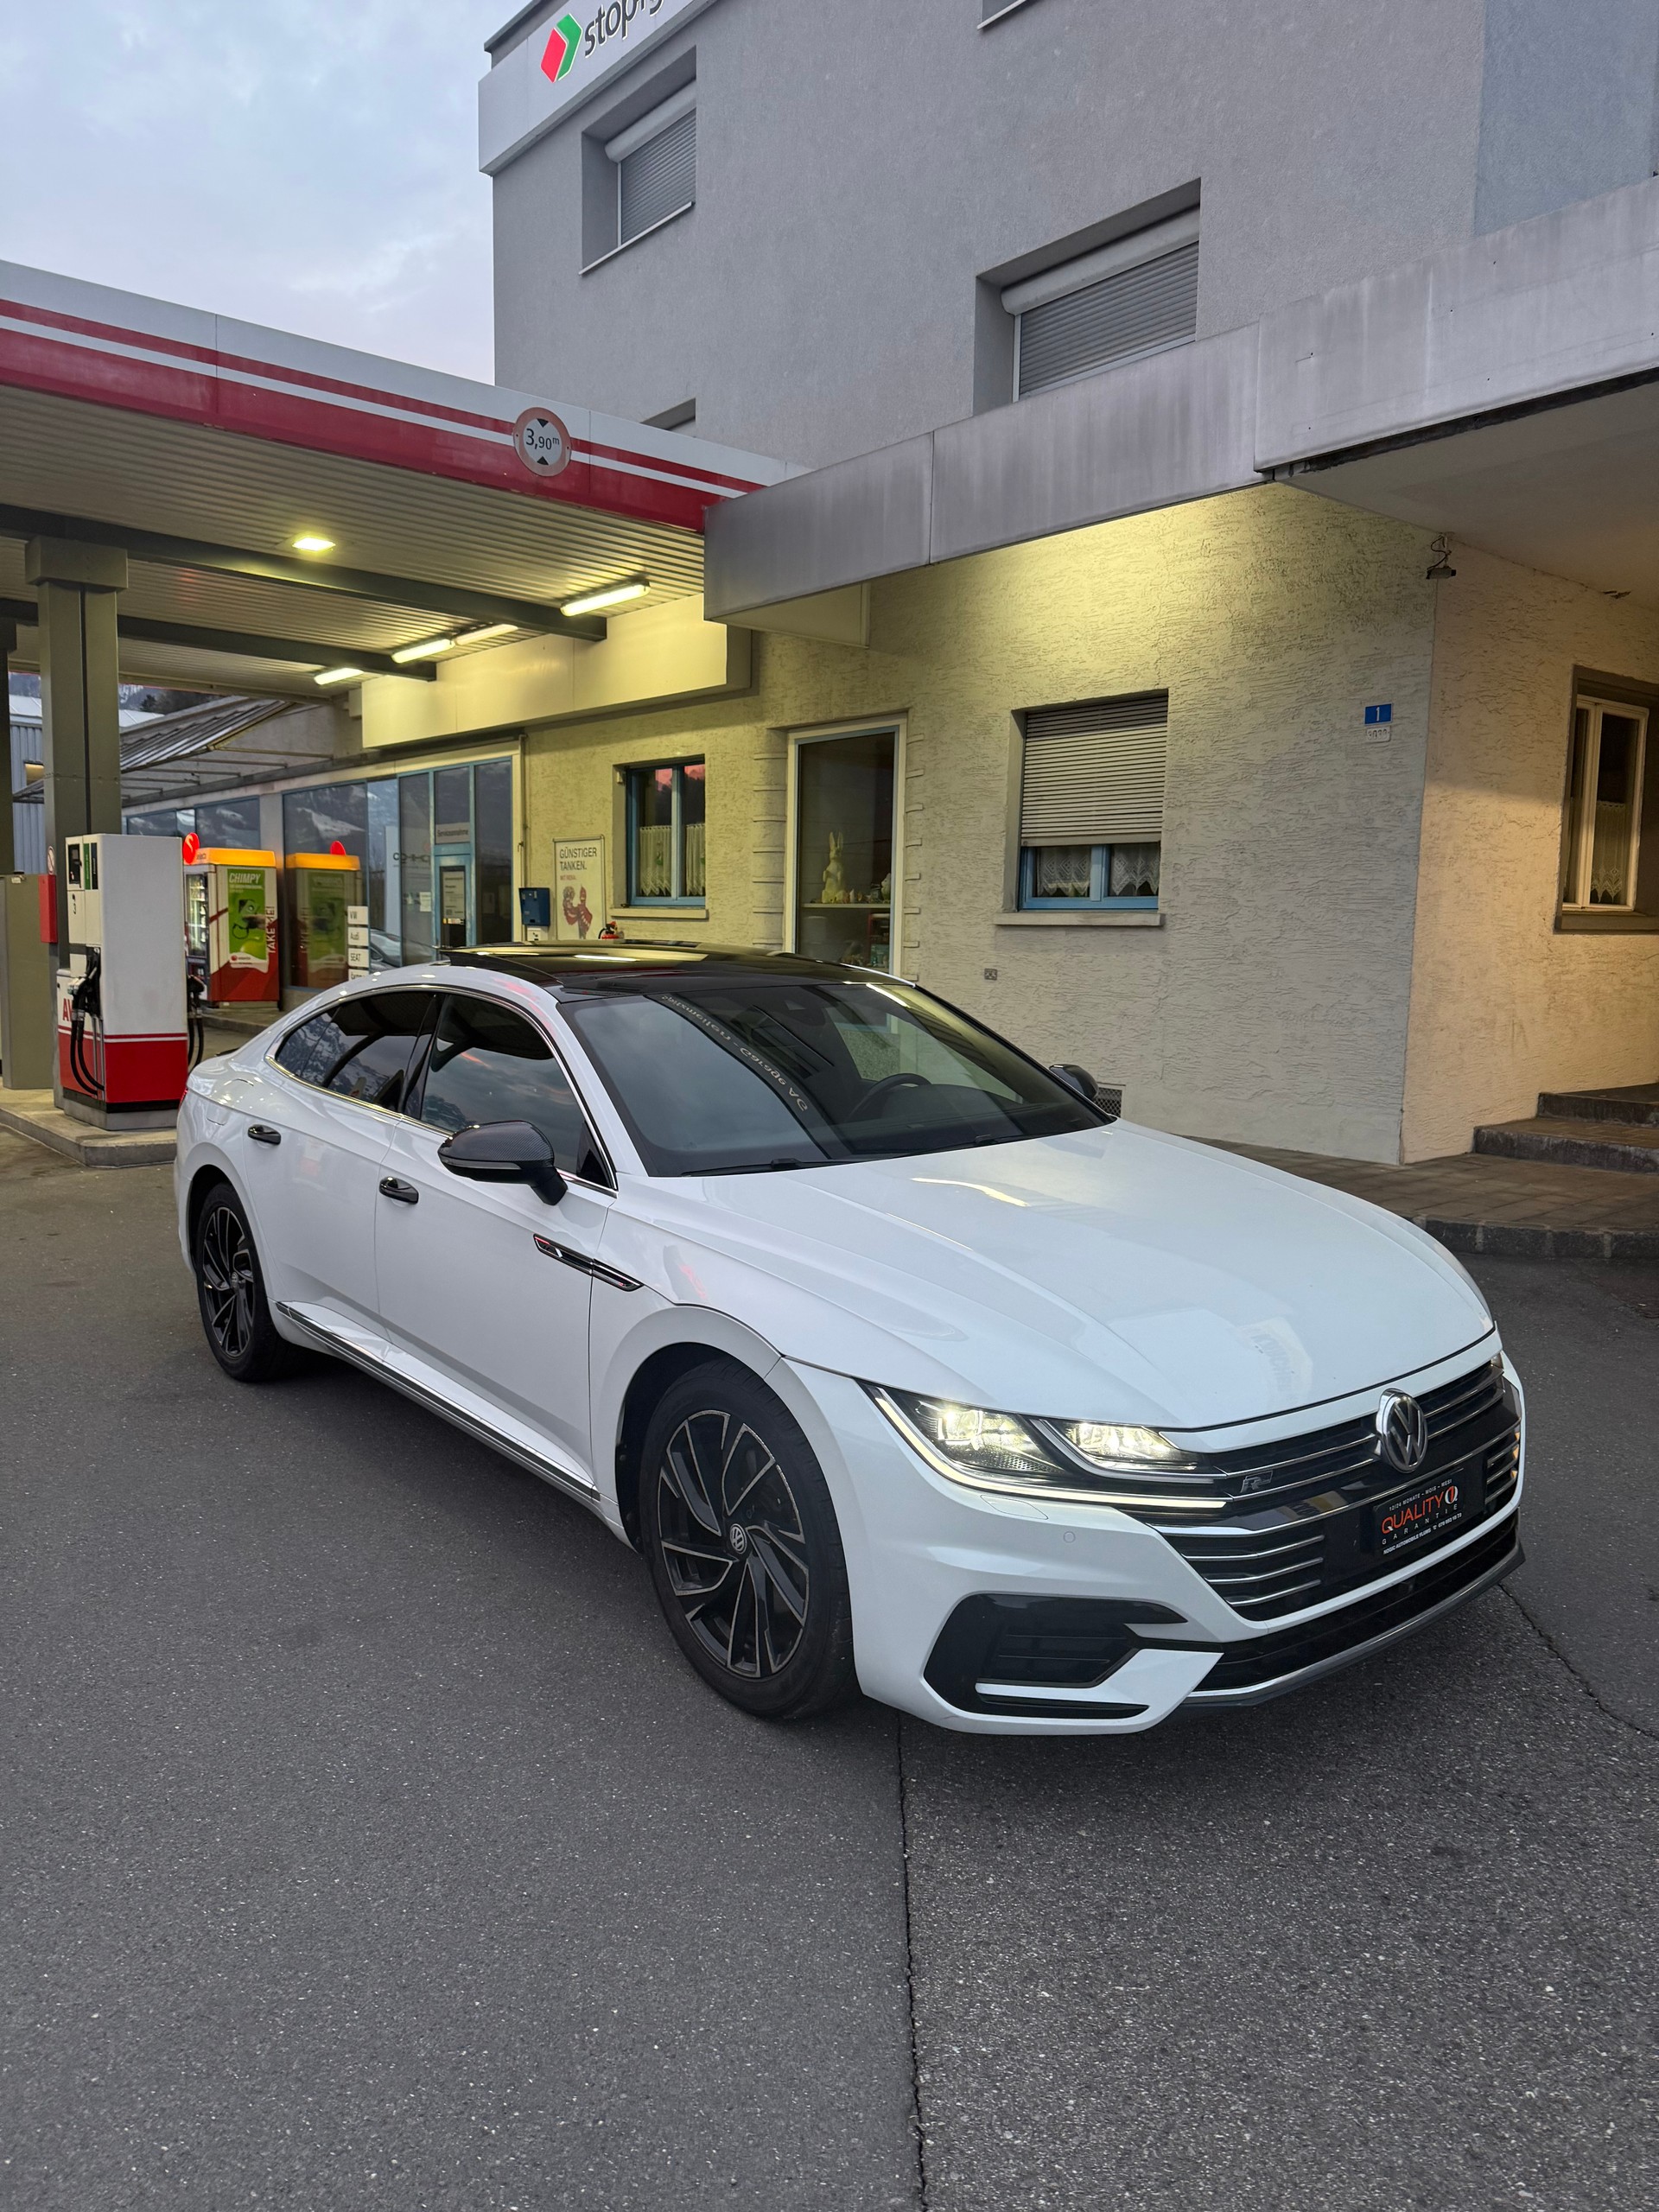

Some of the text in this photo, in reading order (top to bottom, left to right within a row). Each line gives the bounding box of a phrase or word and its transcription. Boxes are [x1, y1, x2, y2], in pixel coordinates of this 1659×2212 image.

[559, 847, 597, 859] GÜNSTIGER
[559, 861, 588, 871] TANKEN.
[229, 873, 262, 885] CHIMPY
[266, 928, 276, 954] TAKE
[350, 952, 361, 962] SEAT
[1381, 1491, 1444, 1535] QUALITY
[1382, 1503, 1458, 1545] GARANTIE
